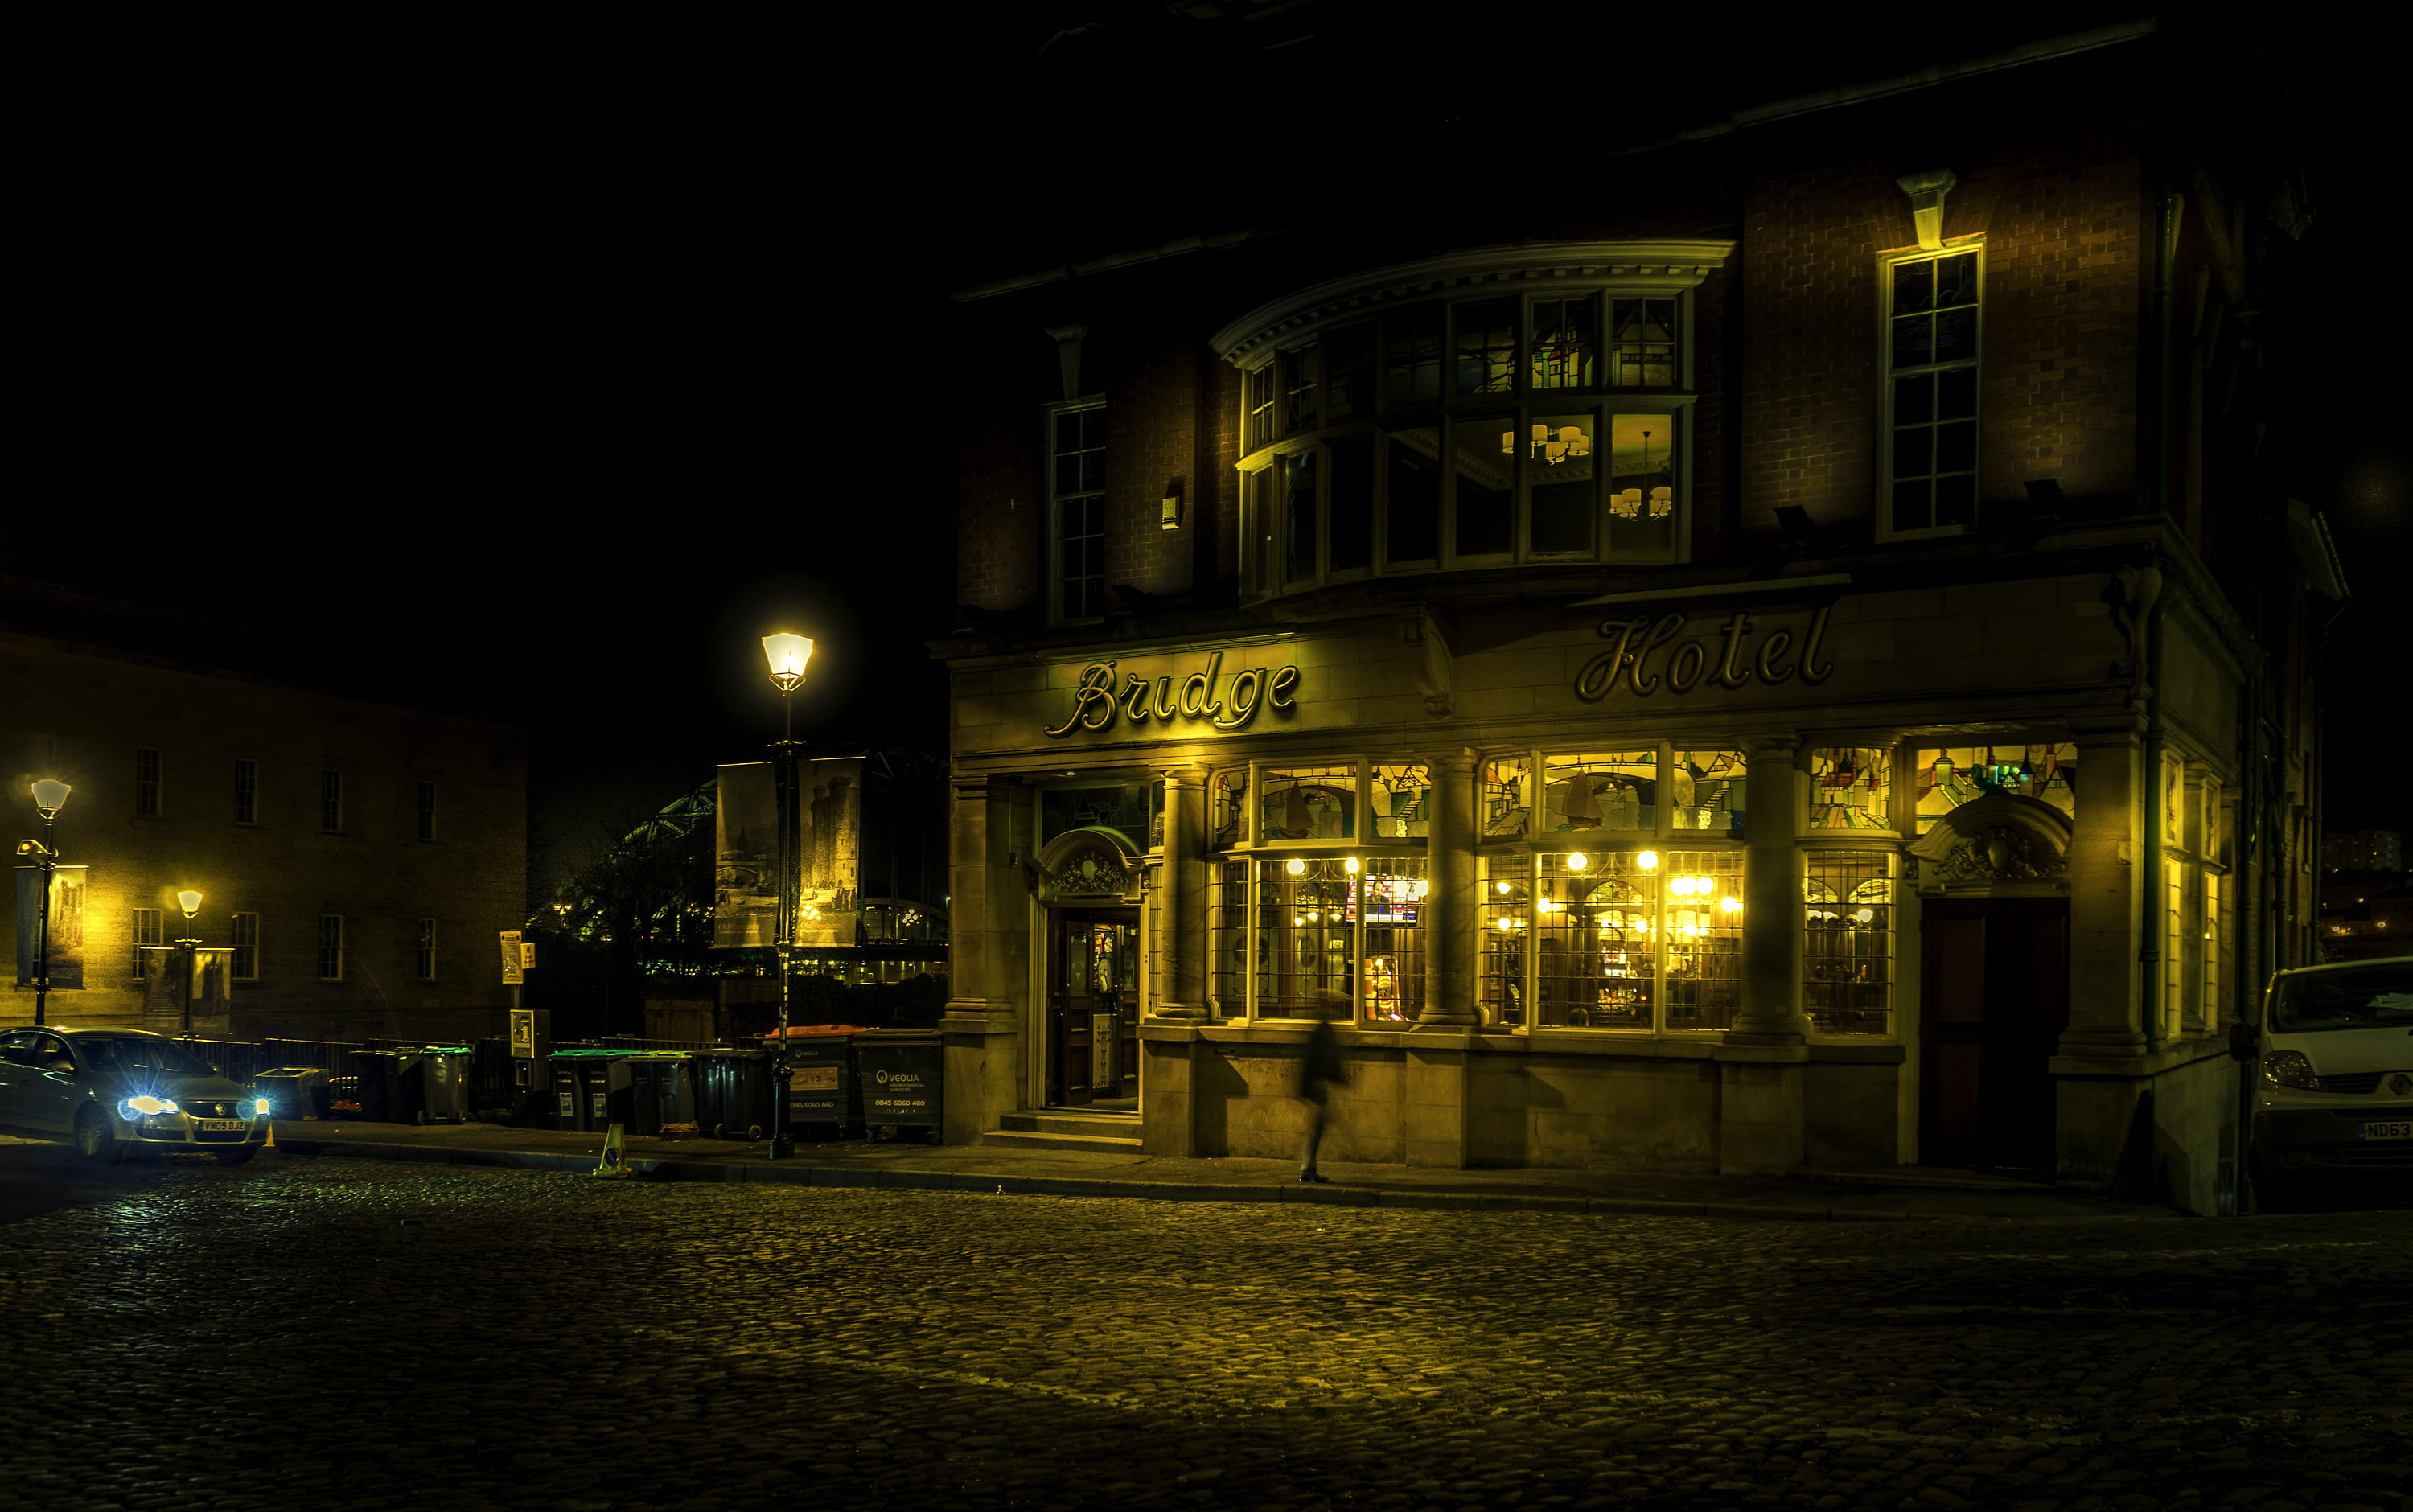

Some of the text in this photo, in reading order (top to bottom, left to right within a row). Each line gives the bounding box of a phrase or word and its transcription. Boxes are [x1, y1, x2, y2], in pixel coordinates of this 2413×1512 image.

[1044, 605, 1834, 739] Bridge Hotel
[2368, 1124, 2410, 1136] ND63
